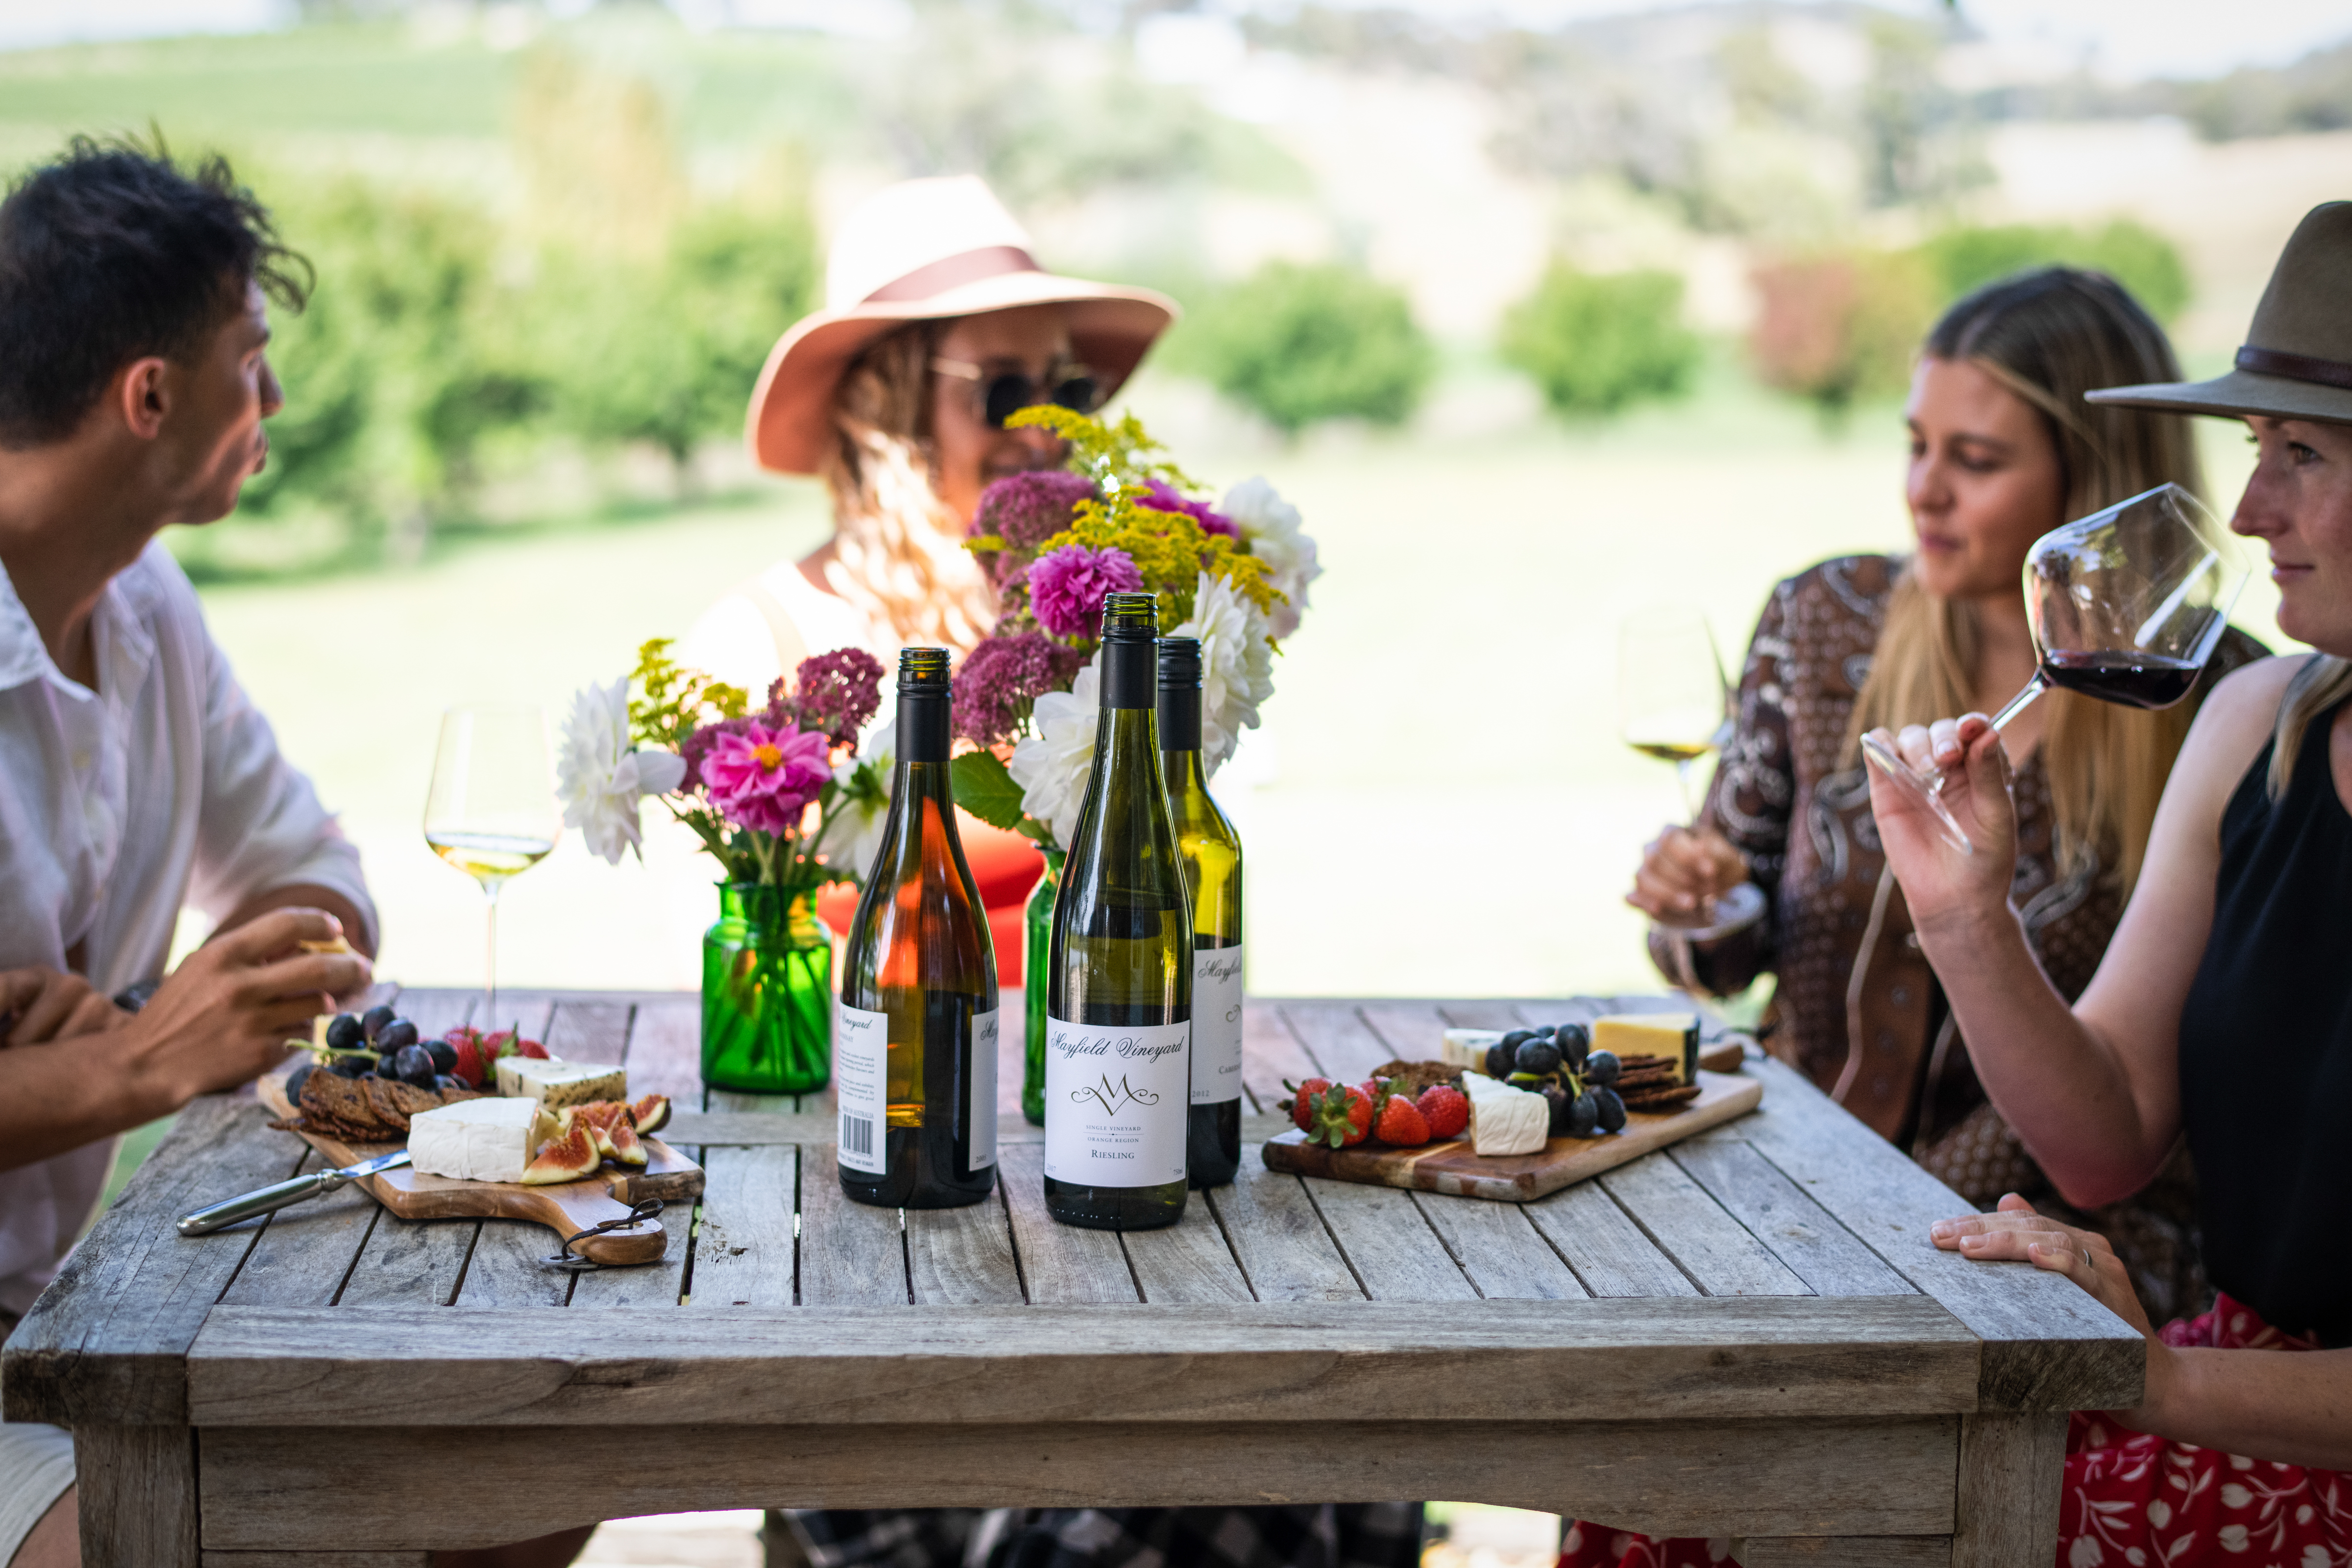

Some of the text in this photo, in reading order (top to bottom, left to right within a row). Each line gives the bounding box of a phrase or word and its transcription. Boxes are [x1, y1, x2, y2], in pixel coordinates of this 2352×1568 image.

[842, 1009, 873, 1031] Vineyard
[1051, 1031, 1184, 1063] Mayfield Vineyard
[854, 1109, 874, 1119] AUSTRALIA
